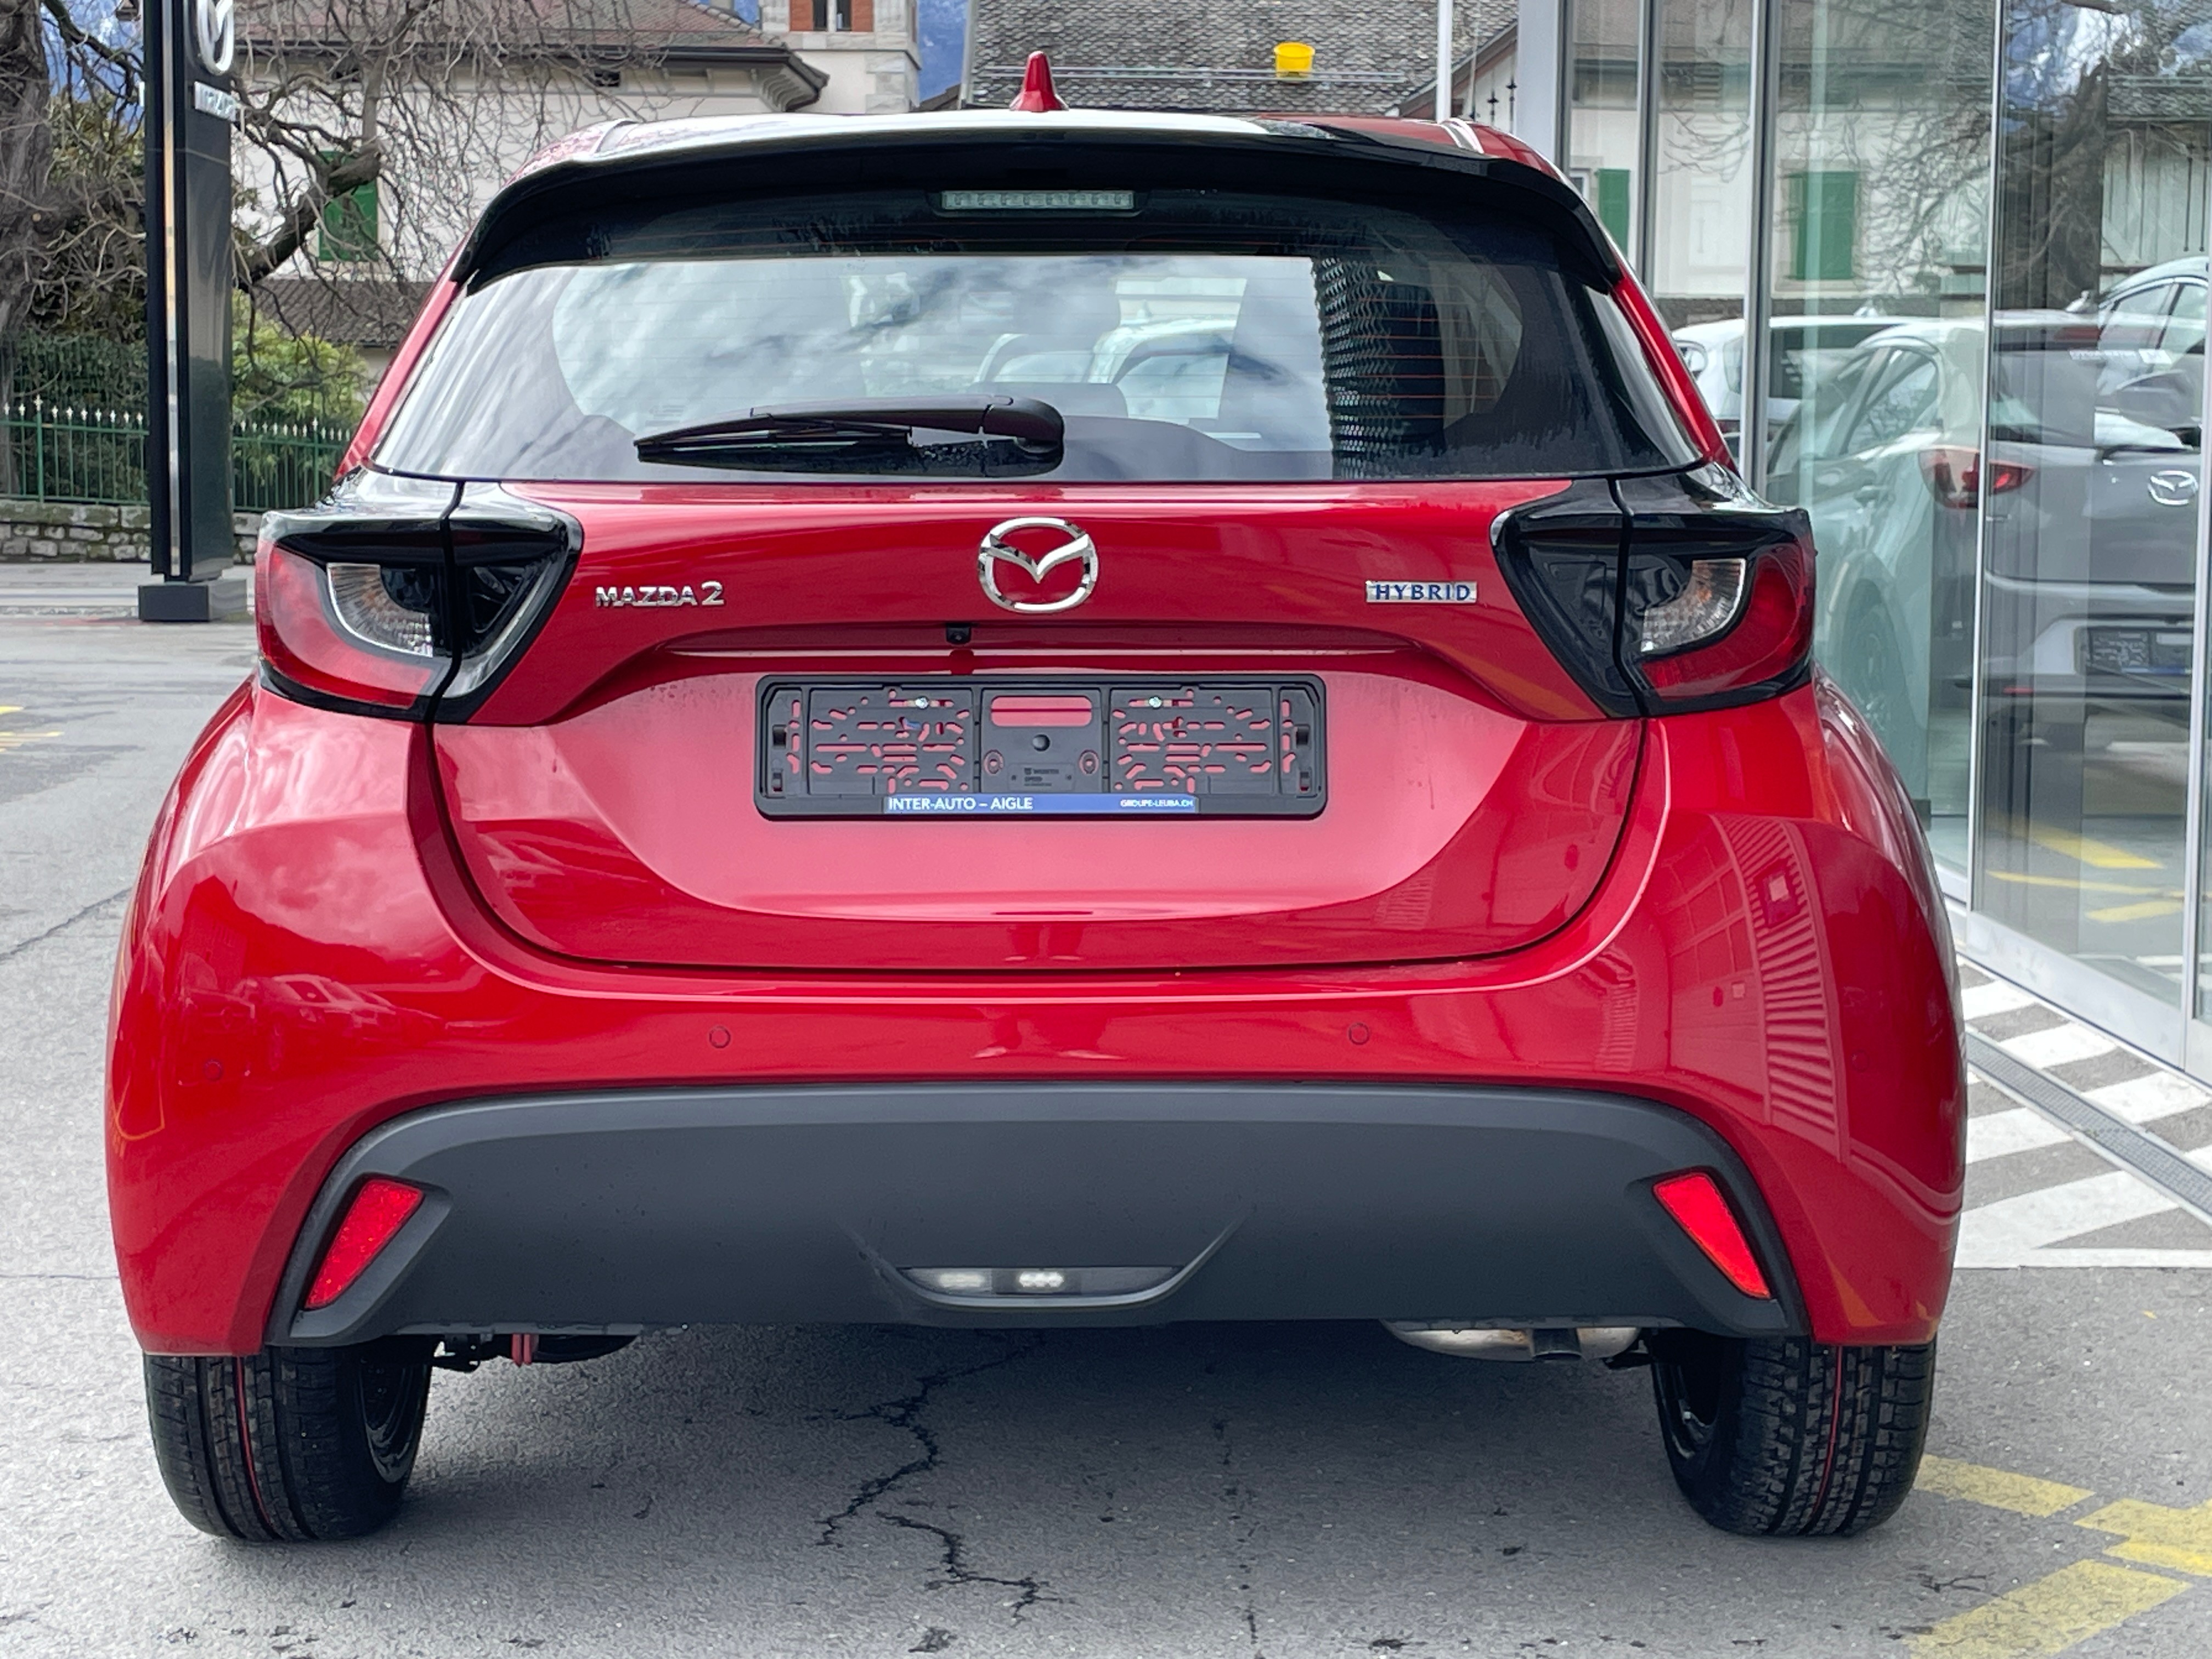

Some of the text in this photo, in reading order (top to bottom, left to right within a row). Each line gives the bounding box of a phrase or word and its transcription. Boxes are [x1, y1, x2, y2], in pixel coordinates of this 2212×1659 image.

[1375, 584, 1471, 601] HYBRID
[888, 797, 976, 810] INTER-AUTO
[990, 797, 1034, 810] AIGLE
